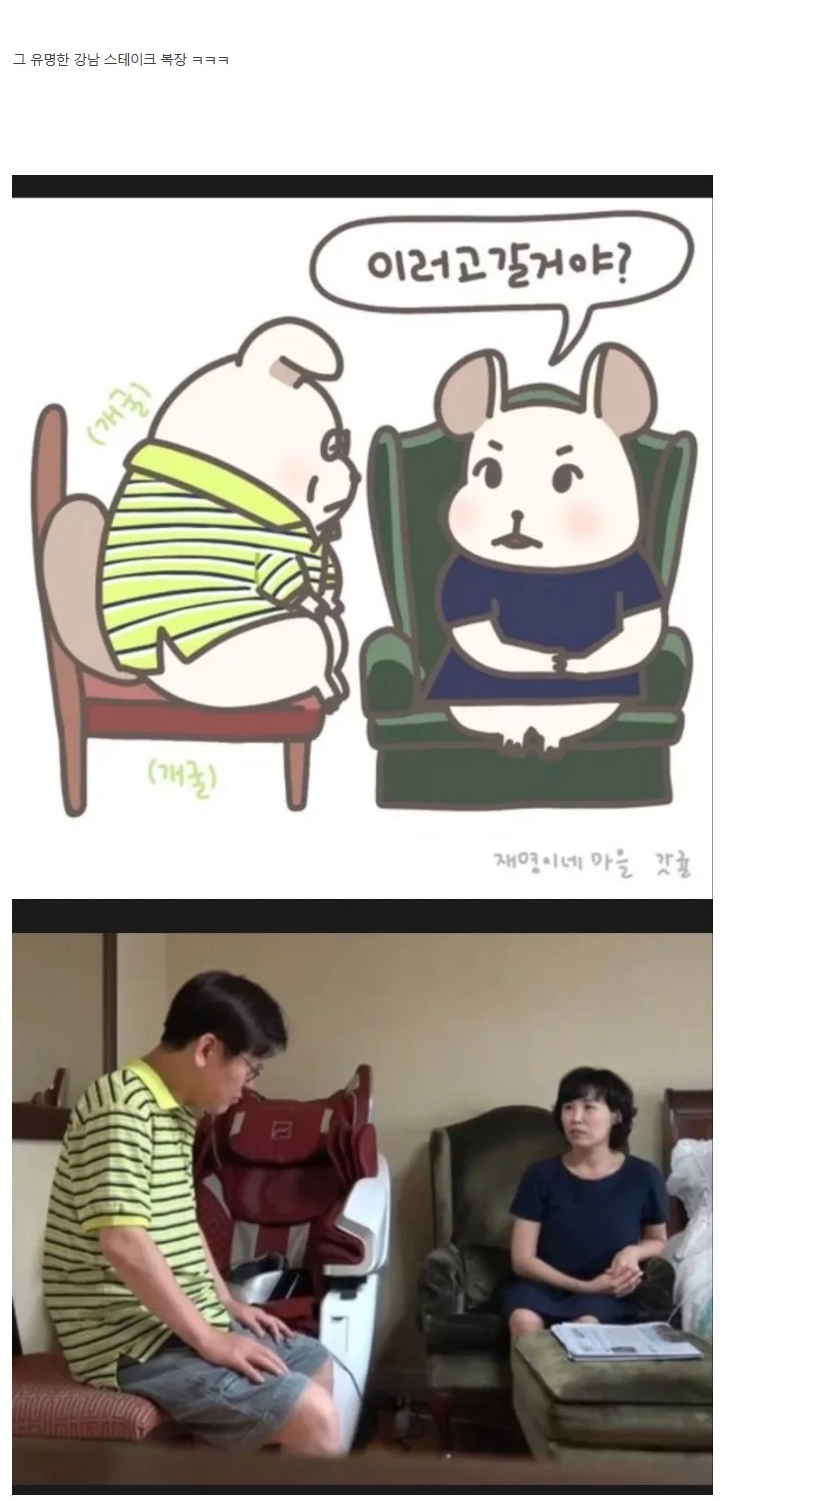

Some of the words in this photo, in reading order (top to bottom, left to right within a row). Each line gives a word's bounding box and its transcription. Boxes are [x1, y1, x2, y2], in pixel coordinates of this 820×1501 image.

[87, 381, 152, 446] (개굴)
[147, 758, 218, 800] (개굴)
[493, 851, 584, 875] 재명이네
[590, 847, 634, 880] 마을
